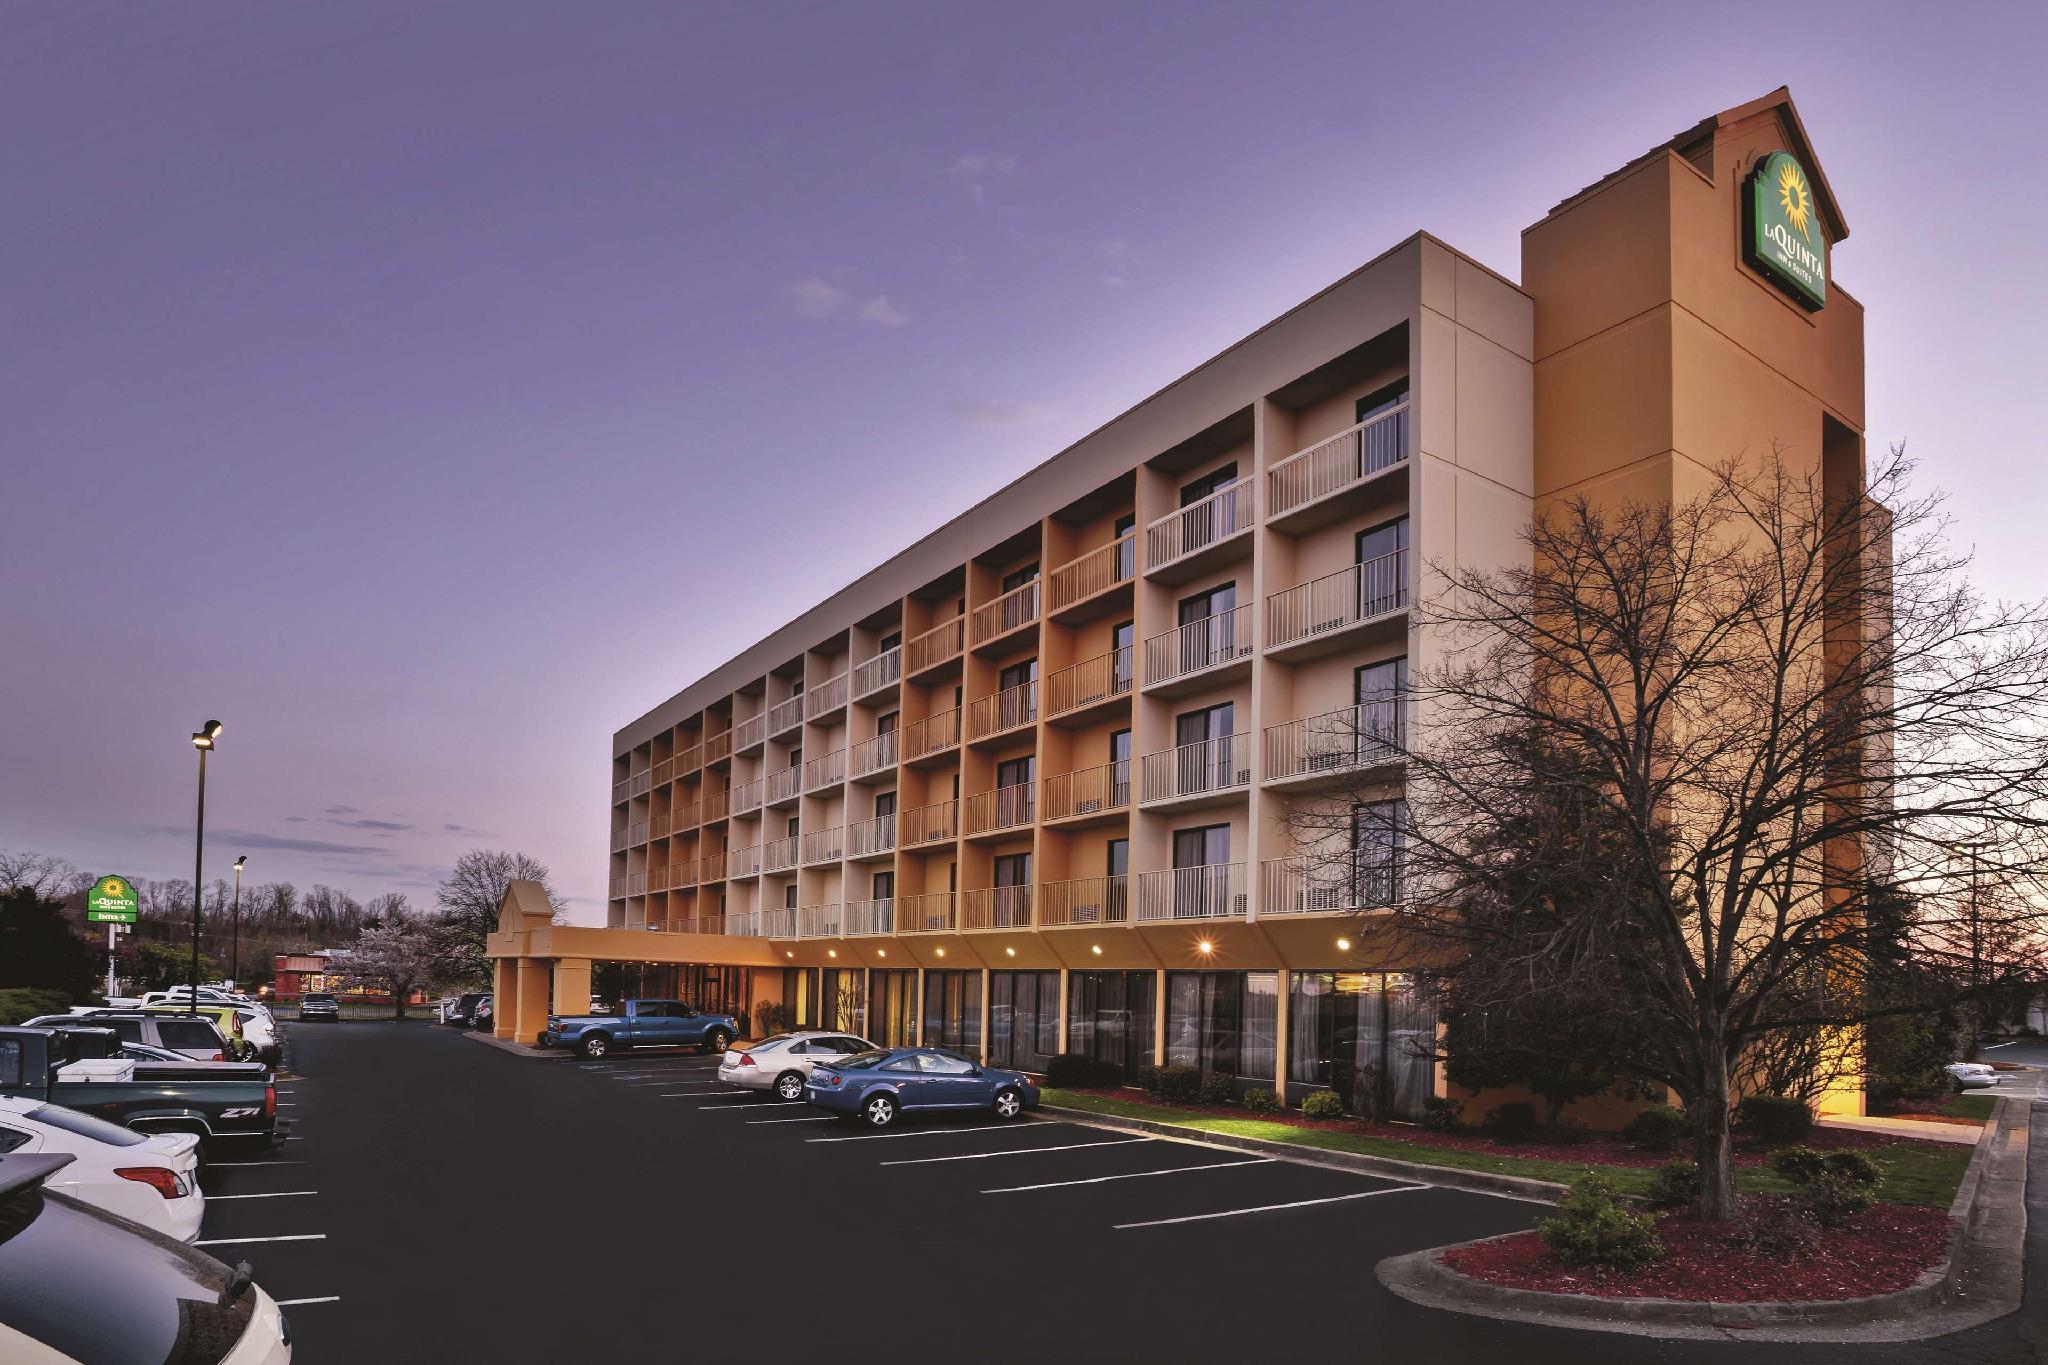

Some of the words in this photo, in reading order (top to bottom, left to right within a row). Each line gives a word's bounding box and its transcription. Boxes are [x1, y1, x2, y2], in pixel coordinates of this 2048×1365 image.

[1775, 224, 1824, 280] QUINTA
[99, 898, 134, 906] QUINTA
[220, 1107, 260, 1118] Z71
